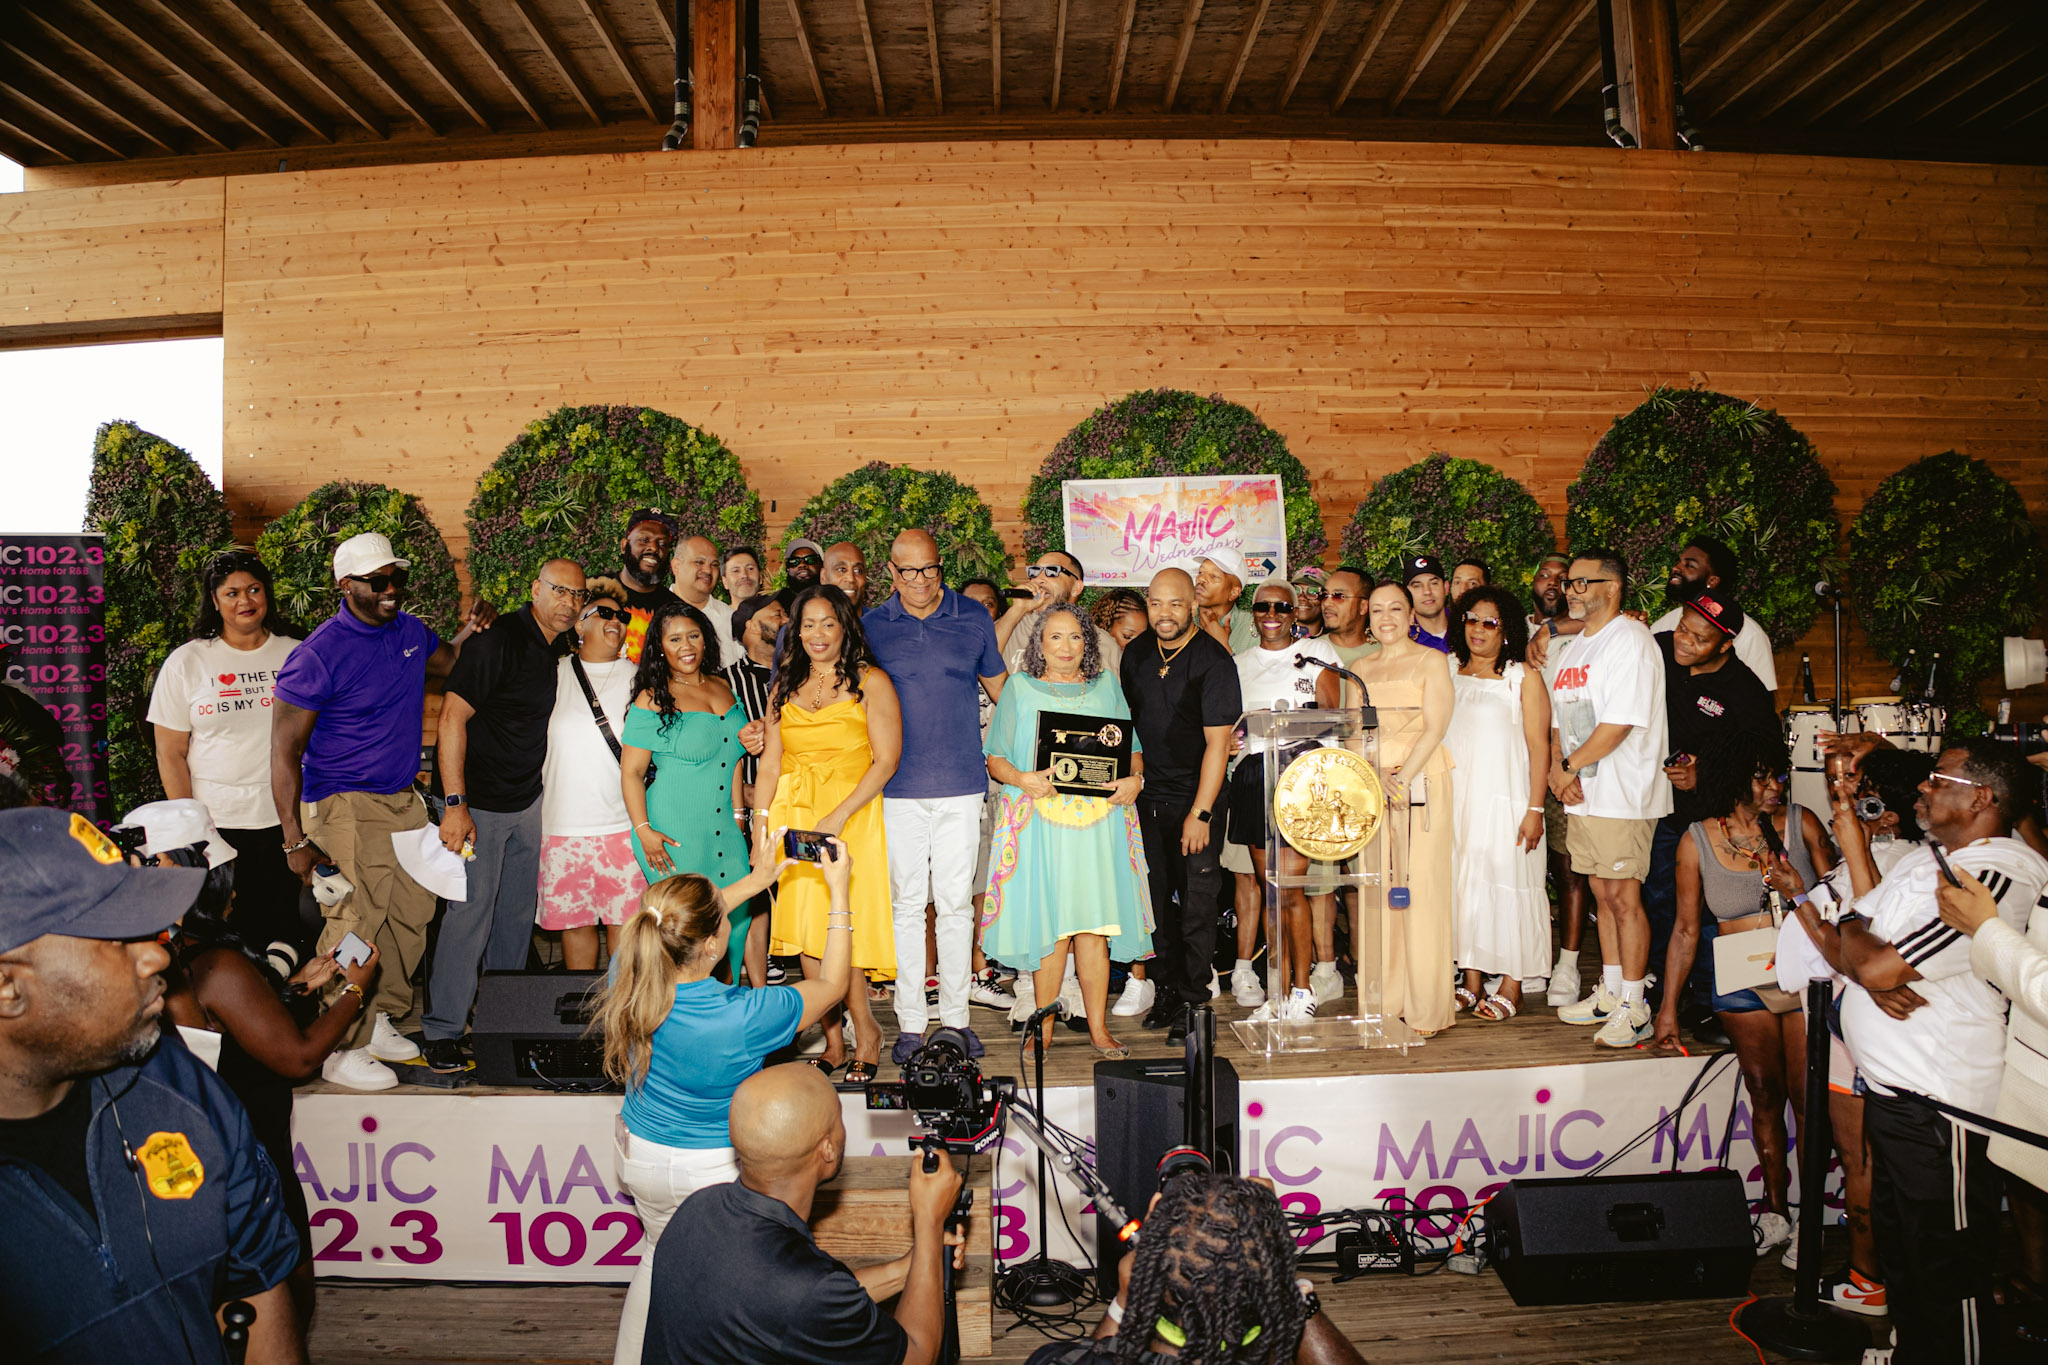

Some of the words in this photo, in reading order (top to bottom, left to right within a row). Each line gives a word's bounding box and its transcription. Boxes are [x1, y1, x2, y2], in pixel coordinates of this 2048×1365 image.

[20, 566, 51, 575] Home
[53, 566, 66, 575] for
[69, 567, 89, 575] R&B
[20, 606, 52, 615] Home
[54, 606, 67, 615] for
[70, 606, 90, 614] R&B
[21, 646, 53, 655] Home
[55, 646, 68, 655] for
[71, 645, 91, 654] R&B
[238, 671, 268, 683] THE
[29, 685, 55, 694] ome
[56, 685, 70, 693] for
[72, 684, 92, 693] R&B
[245, 686, 265, 694] BUT
[198, 704, 214, 716] DC
[217, 701, 230, 713] IS
[234, 699, 254, 711] MY
[73, 723, 94, 732] R&B
[75, 762, 95, 771] R&B
[975, 1128, 999, 1152] RONIN
[310, 1208, 443, 1264] 2.3
[488, 1211, 645, 1266] 102
